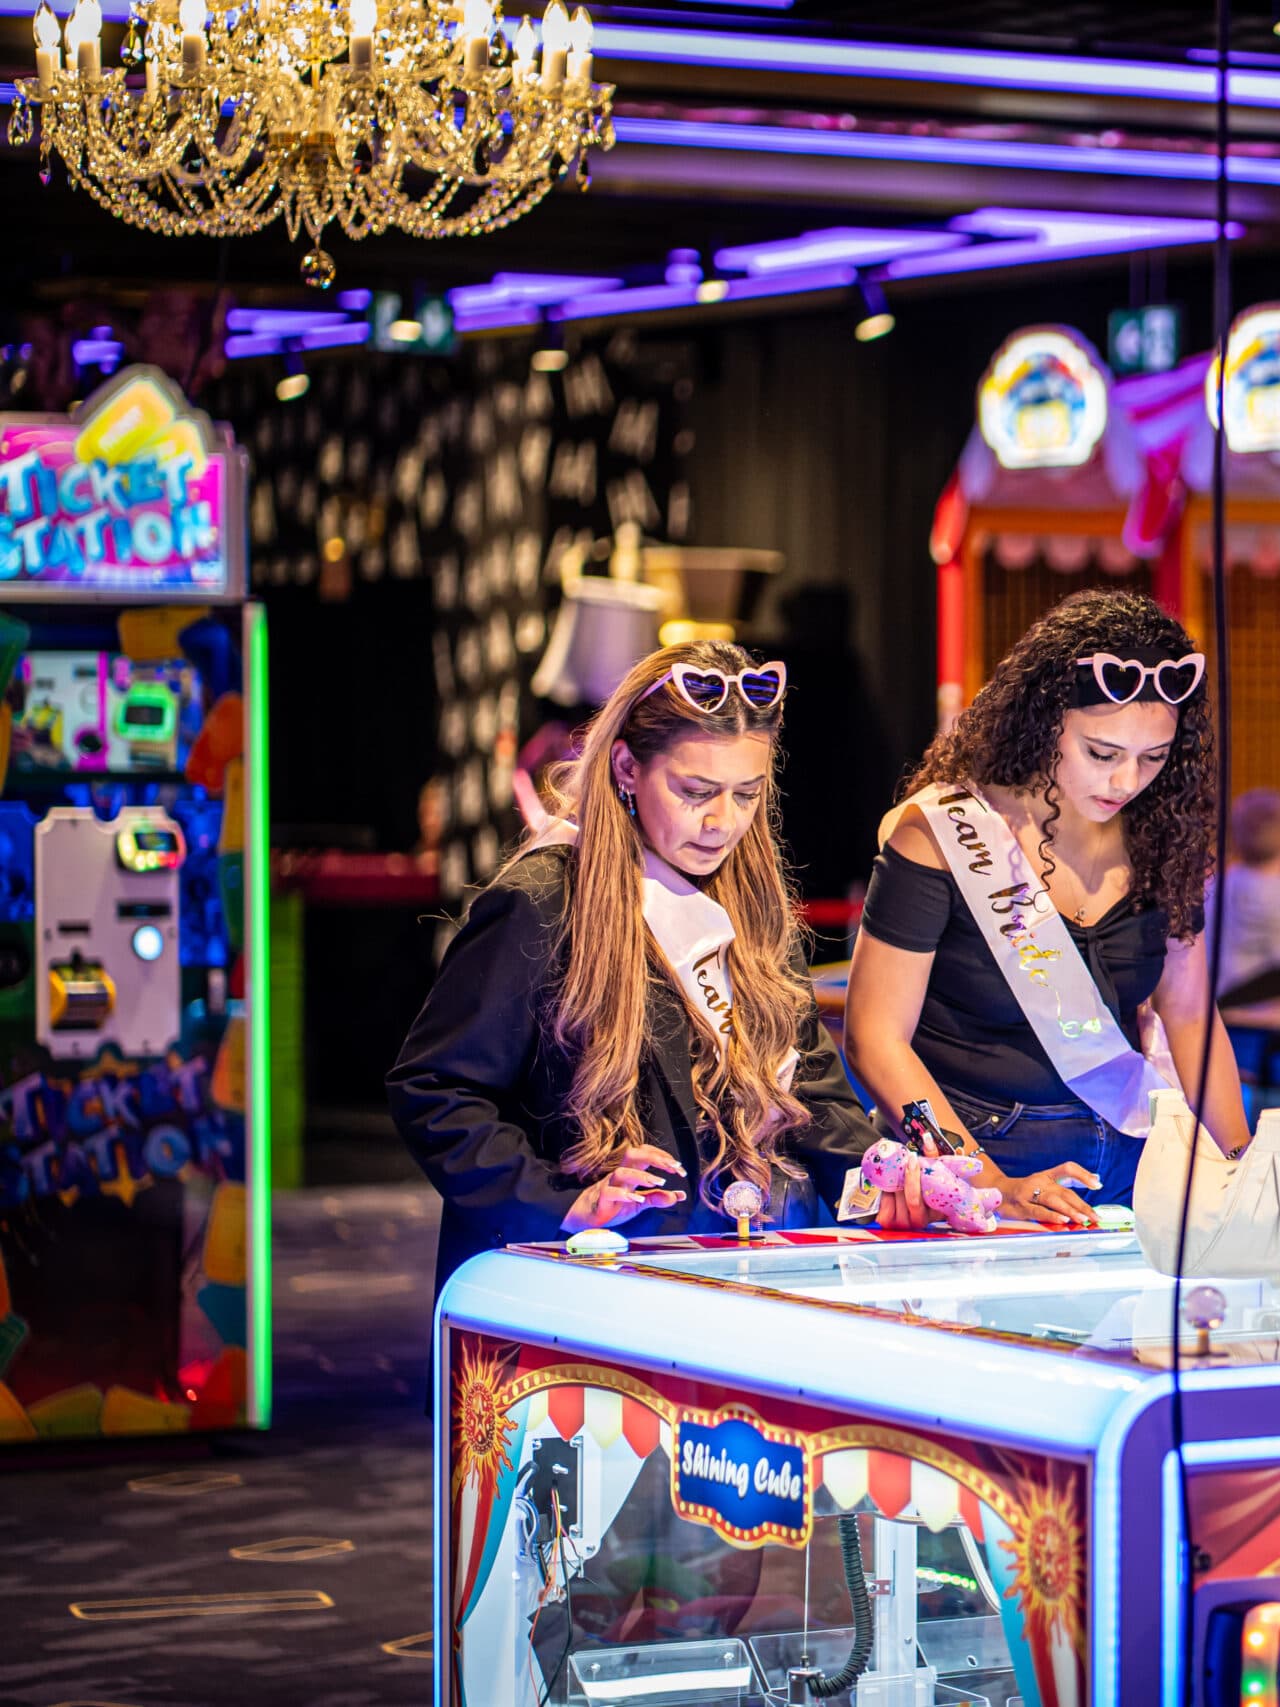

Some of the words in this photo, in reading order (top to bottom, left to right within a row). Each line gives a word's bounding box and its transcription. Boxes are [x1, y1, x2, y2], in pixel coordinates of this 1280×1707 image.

[0, 450, 194, 521] TICKET
[938, 784, 992, 876] Team
[682, 1440, 749, 1498] Shining
[754, 1457, 800, 1501] Cube
